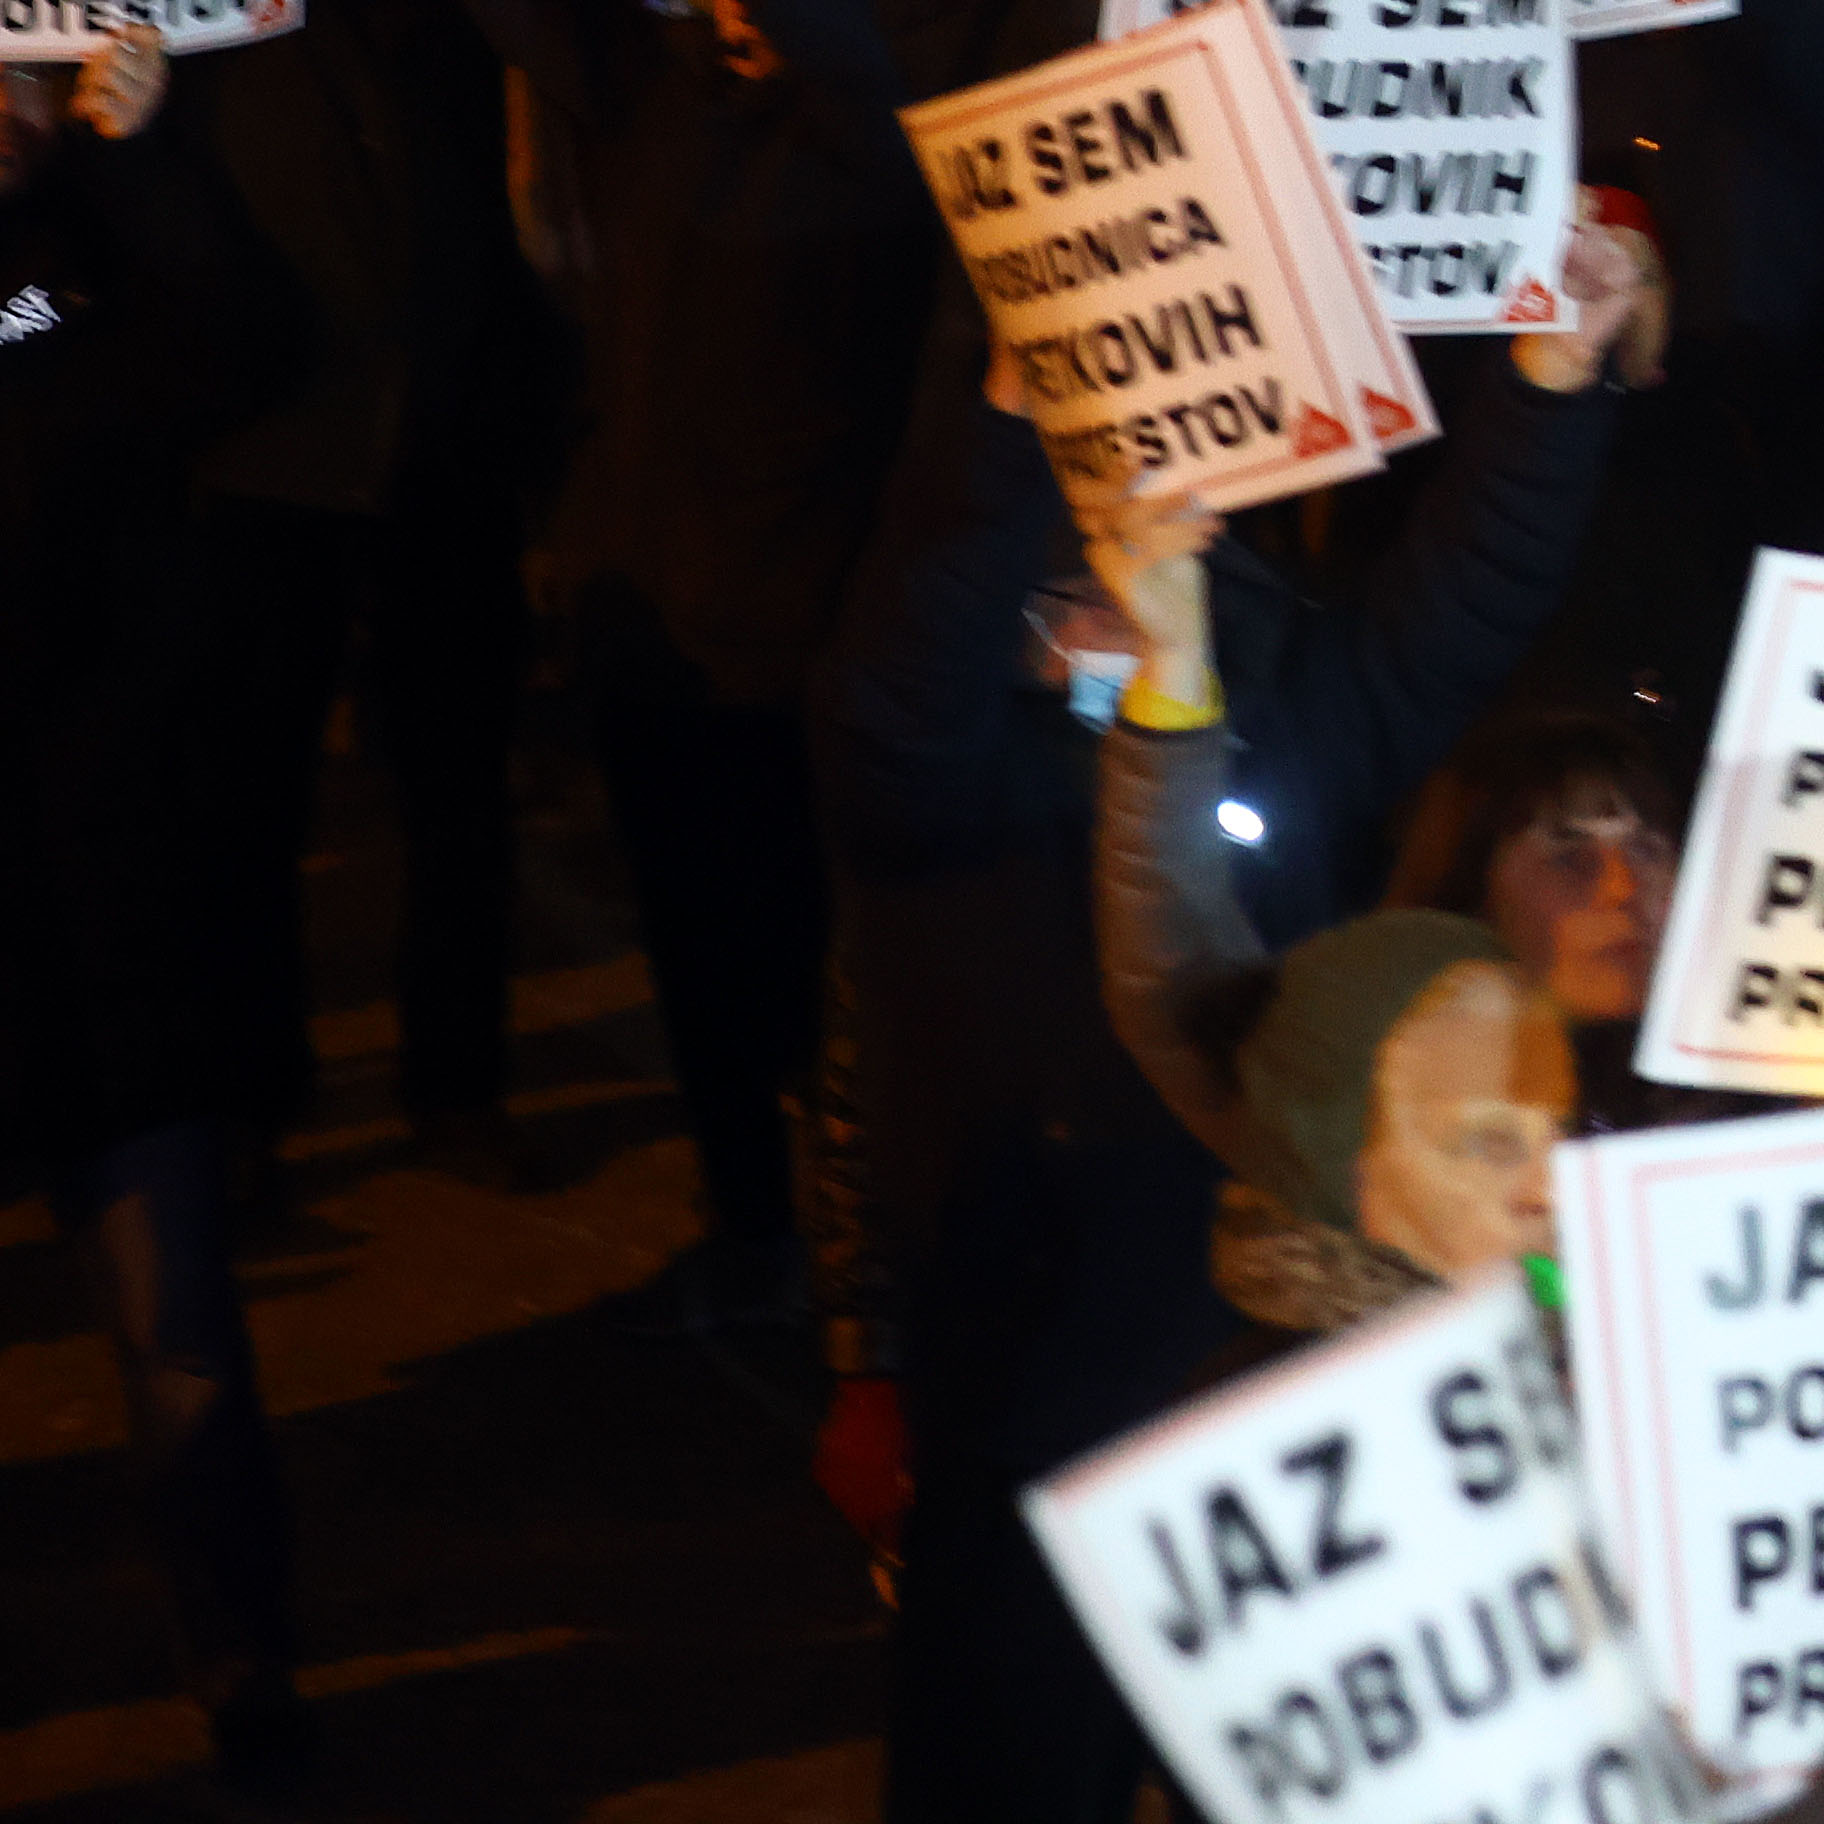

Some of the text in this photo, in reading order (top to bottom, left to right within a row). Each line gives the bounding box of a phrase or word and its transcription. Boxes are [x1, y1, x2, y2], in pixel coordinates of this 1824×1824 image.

[1292, 55, 1545, 120] UDNIK
[1022, 84, 1192, 196] SEM
[1334, 150, 1538, 218] OVIH
[1140, 1428, 1390, 1658] JAZ
